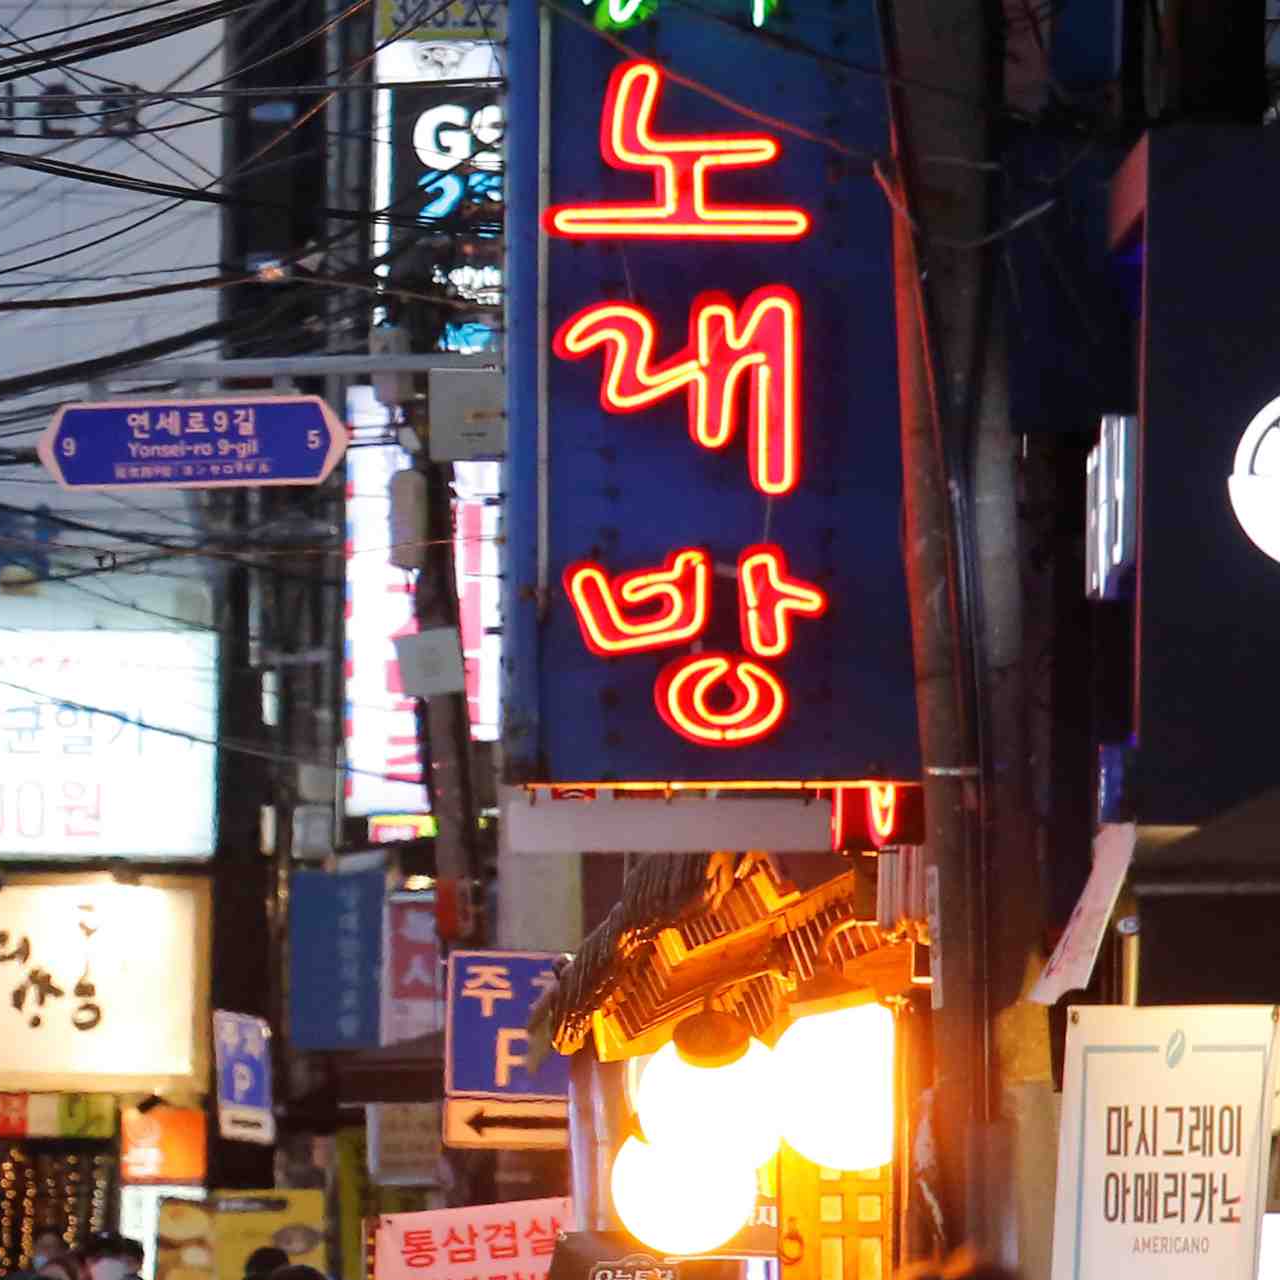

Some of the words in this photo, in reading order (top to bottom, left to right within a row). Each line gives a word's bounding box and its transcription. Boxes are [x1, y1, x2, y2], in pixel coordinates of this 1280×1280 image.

[542, 60, 828, 747] 노래방
[63, 438, 76, 456] 9
[307, 430, 321, 449] 5
[1103, 1171, 1242, 1225] 아메리카노
[401, 1216, 562, 1269] 통삼겹살
[1132, 1236, 1210, 1254] AMERICANO
